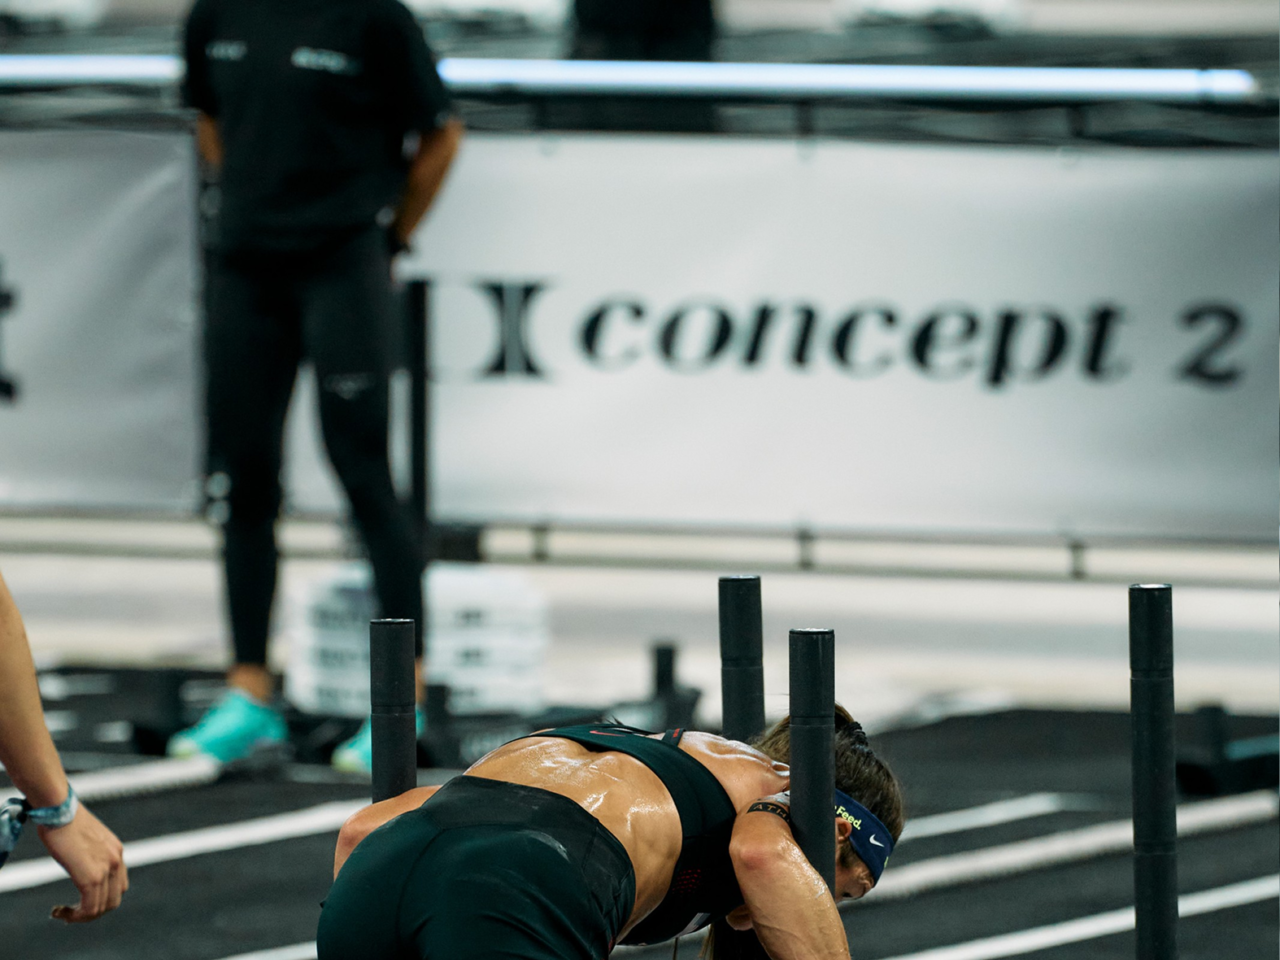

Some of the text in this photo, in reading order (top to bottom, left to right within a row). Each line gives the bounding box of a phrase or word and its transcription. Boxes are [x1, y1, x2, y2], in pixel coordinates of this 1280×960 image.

[578, 298, 1246, 391] concept 2
[836, 806, 862, 831] Feed.
